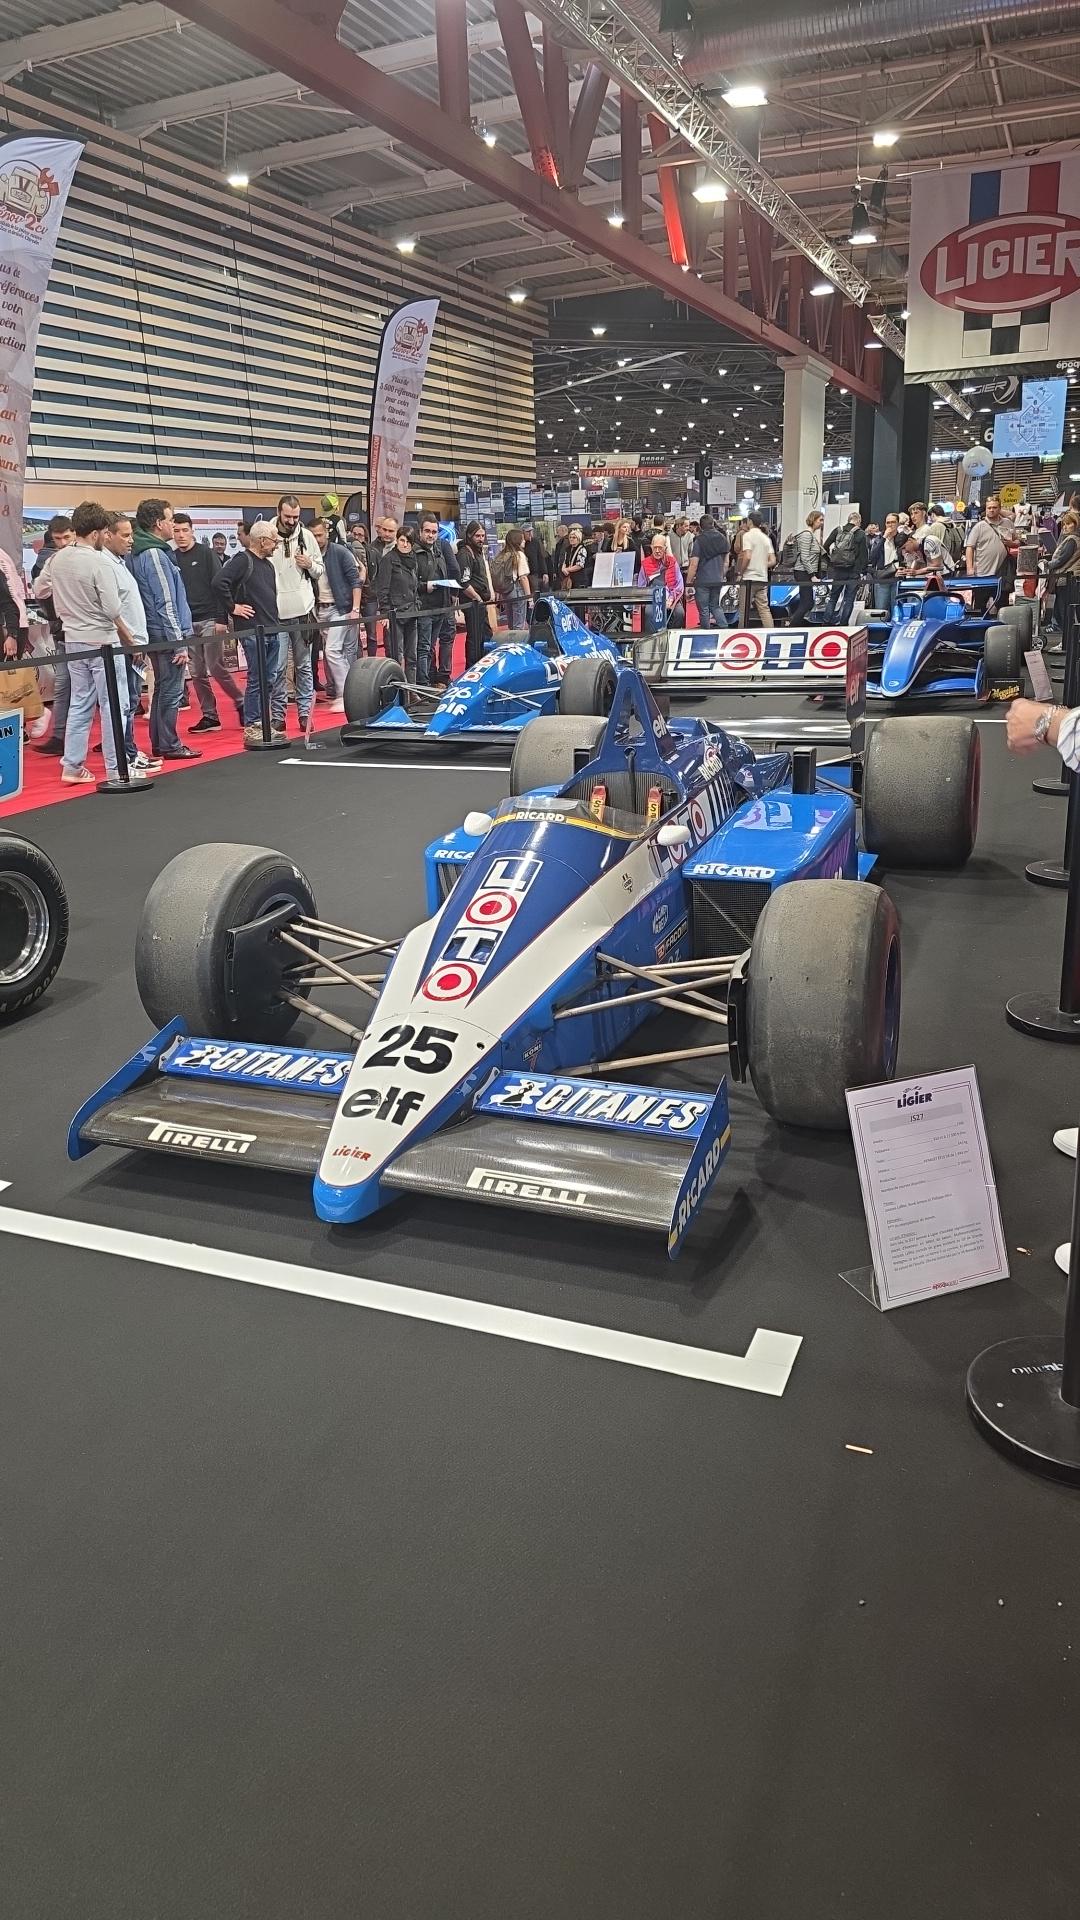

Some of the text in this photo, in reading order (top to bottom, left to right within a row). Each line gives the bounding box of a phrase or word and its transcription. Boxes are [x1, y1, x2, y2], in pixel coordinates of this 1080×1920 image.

[936, 230, 1080, 295] LIGIER
[703, 465, 711, 477] 6
[674, 631, 849, 670] LOTO
[434, 702, 467, 716] elf
[442, 687, 472, 699] 26
[653, 714, 667, 739] elf
[515, 811, 565, 822] RICARD
[693, 863, 775, 879] RICARD
[422, 858, 543, 1002] LOTO
[210, 1048, 351, 1086] GITANES
[362, 1024, 459, 1074] 25
[341, 1086, 426, 1126] elf
[535, 1084, 707, 1131] GITANES
[910, 1113, 924, 1122] JS27
[131, 1116, 257, 1153] PIRELLI
[466, 1167, 602, 1206] PIRELLI
[677, 1136, 721, 1232] RICARD
